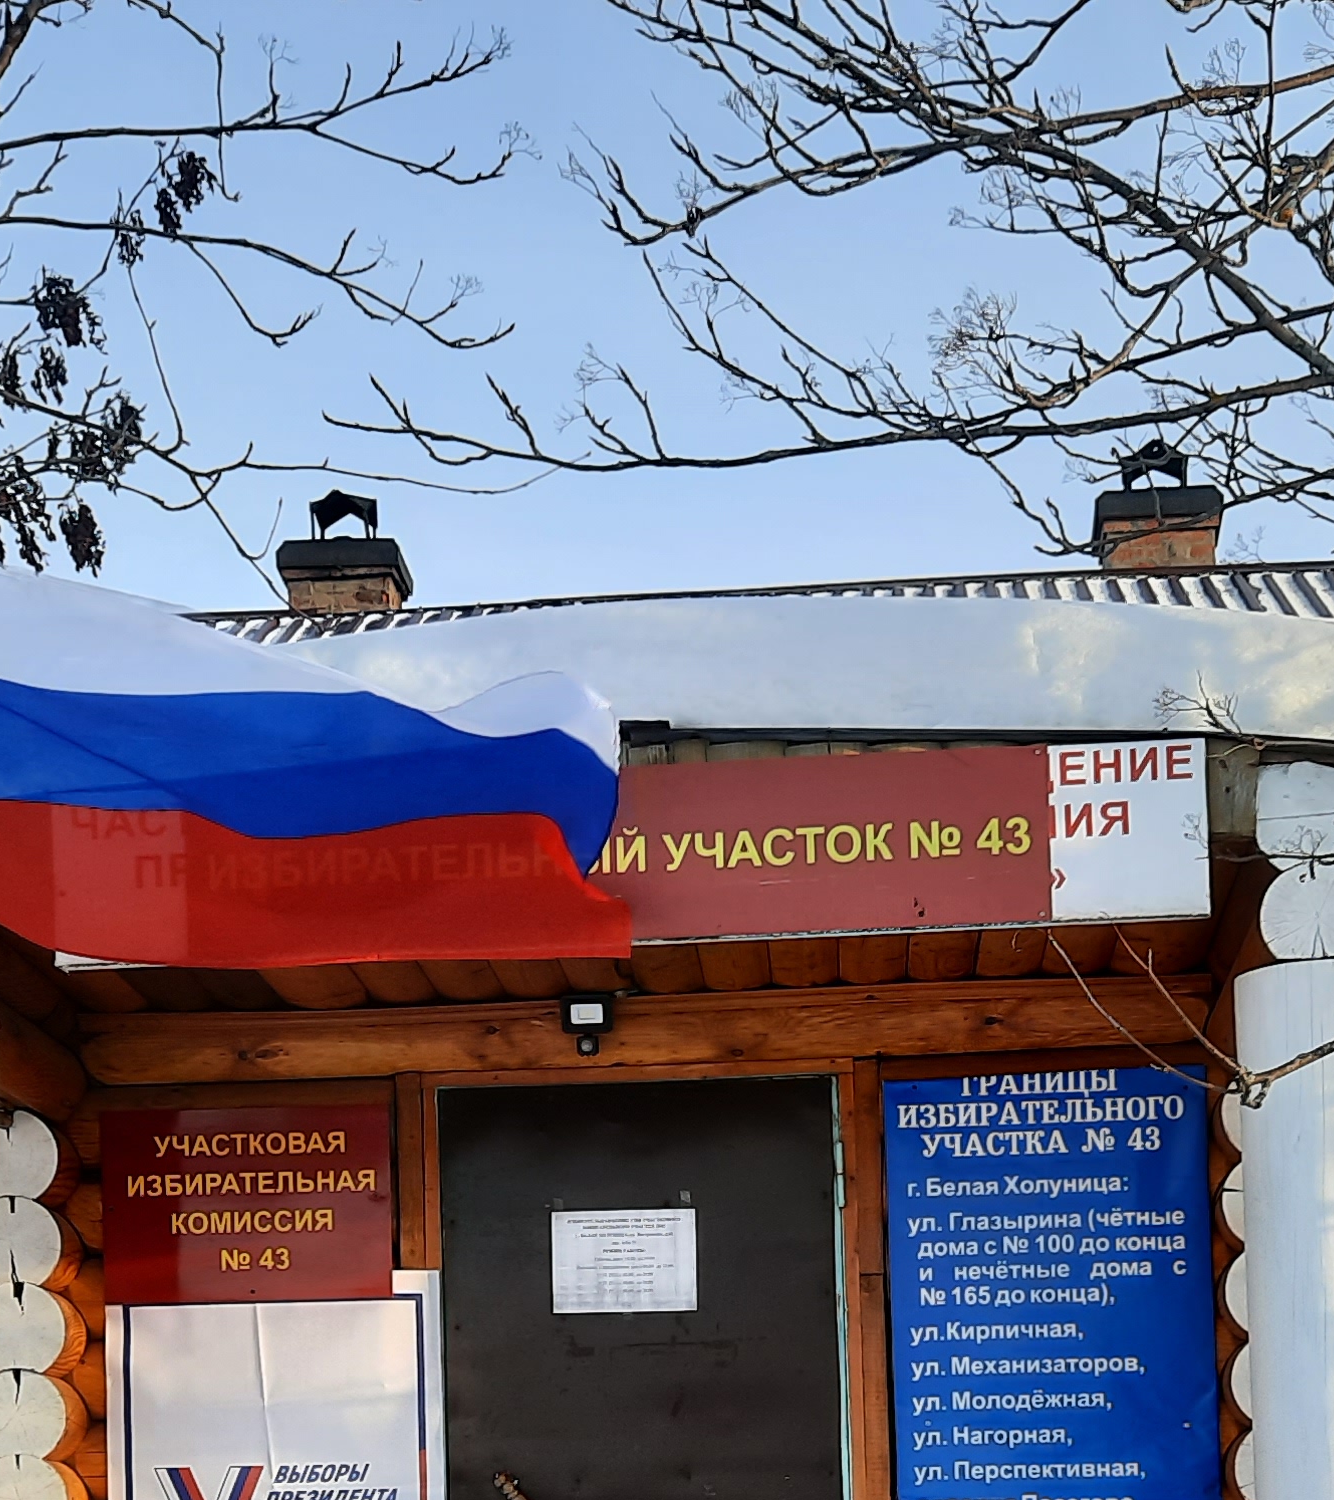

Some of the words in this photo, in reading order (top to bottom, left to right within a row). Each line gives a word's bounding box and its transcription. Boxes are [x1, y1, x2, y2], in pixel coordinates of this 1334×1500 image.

[1048, 744, 1193, 793] ЕНИЕ
[662, 821, 894, 871] УЧАСТОК
[908, 820, 961, 860] №
[976, 816, 1033, 857] 43
[897, 1095, 1184, 1129] ИЗБИРАТЕЛЬНОГО
[153, 1131, 346, 1158] УЧАСТКОВАЯ
[920, 1130, 1068, 1157] УЧАСТКА
[1082, 1128, 1115, 1152] №
[1127, 1126, 1161, 1150] 43
[127, 1169, 376, 1197] ИЗБИРАТЕЛЬНАЯ
[907, 1183, 920, 1197] г.
[926, 1178, 999, 1197] Белая
[1003, 1175, 1129, 1198] Холуница:
[171, 1209, 333, 1234] КОМИССИЯ
[907, 1216, 942, 1237] ул.
[949, 1211, 1081, 1233] Глазырина
[1088, 1208, 1185, 1231] (чётные
[221, 1249, 250, 1271] №
[259, 1248, 291, 1270] 43
[918, 1242, 978, 1260] дома
[984, 1240, 997, 1254] с
[1003, 1236, 1028, 1254] №
[1035, 1234, 1074, 1253] 100
[1079, 1237, 1109, 1255] до
[1116, 1234, 1185, 1251] конца
[920, 1267, 932, 1281] и
[955, 1260, 1069, 1279] нечётные
[1090, 1261, 1152, 1279] дома
[1173, 1260, 1186, 1274] с
[920, 1287, 945, 1306] №
[951, 1286, 991, 1305] 165
[995, 1290, 1025, 1307] до
[1031, 1283, 1115, 1306] конца),
[911, 1362, 945, 1381] ул.
[951, 1357, 1145, 1376] Механизаторов,
[912, 1396, 946, 1415] ул.
[952, 1390, 1113, 1412] Молодёжная,
[913, 1430, 947, 1450] ул.
[953, 1427, 1073, 1448] Нагорная,
[273, 1464, 369, 1483] ВЫБОРЫ
[914, 1465, 948, 1484] ул.
[954, 1461, 1146, 1483] Перспективная,
